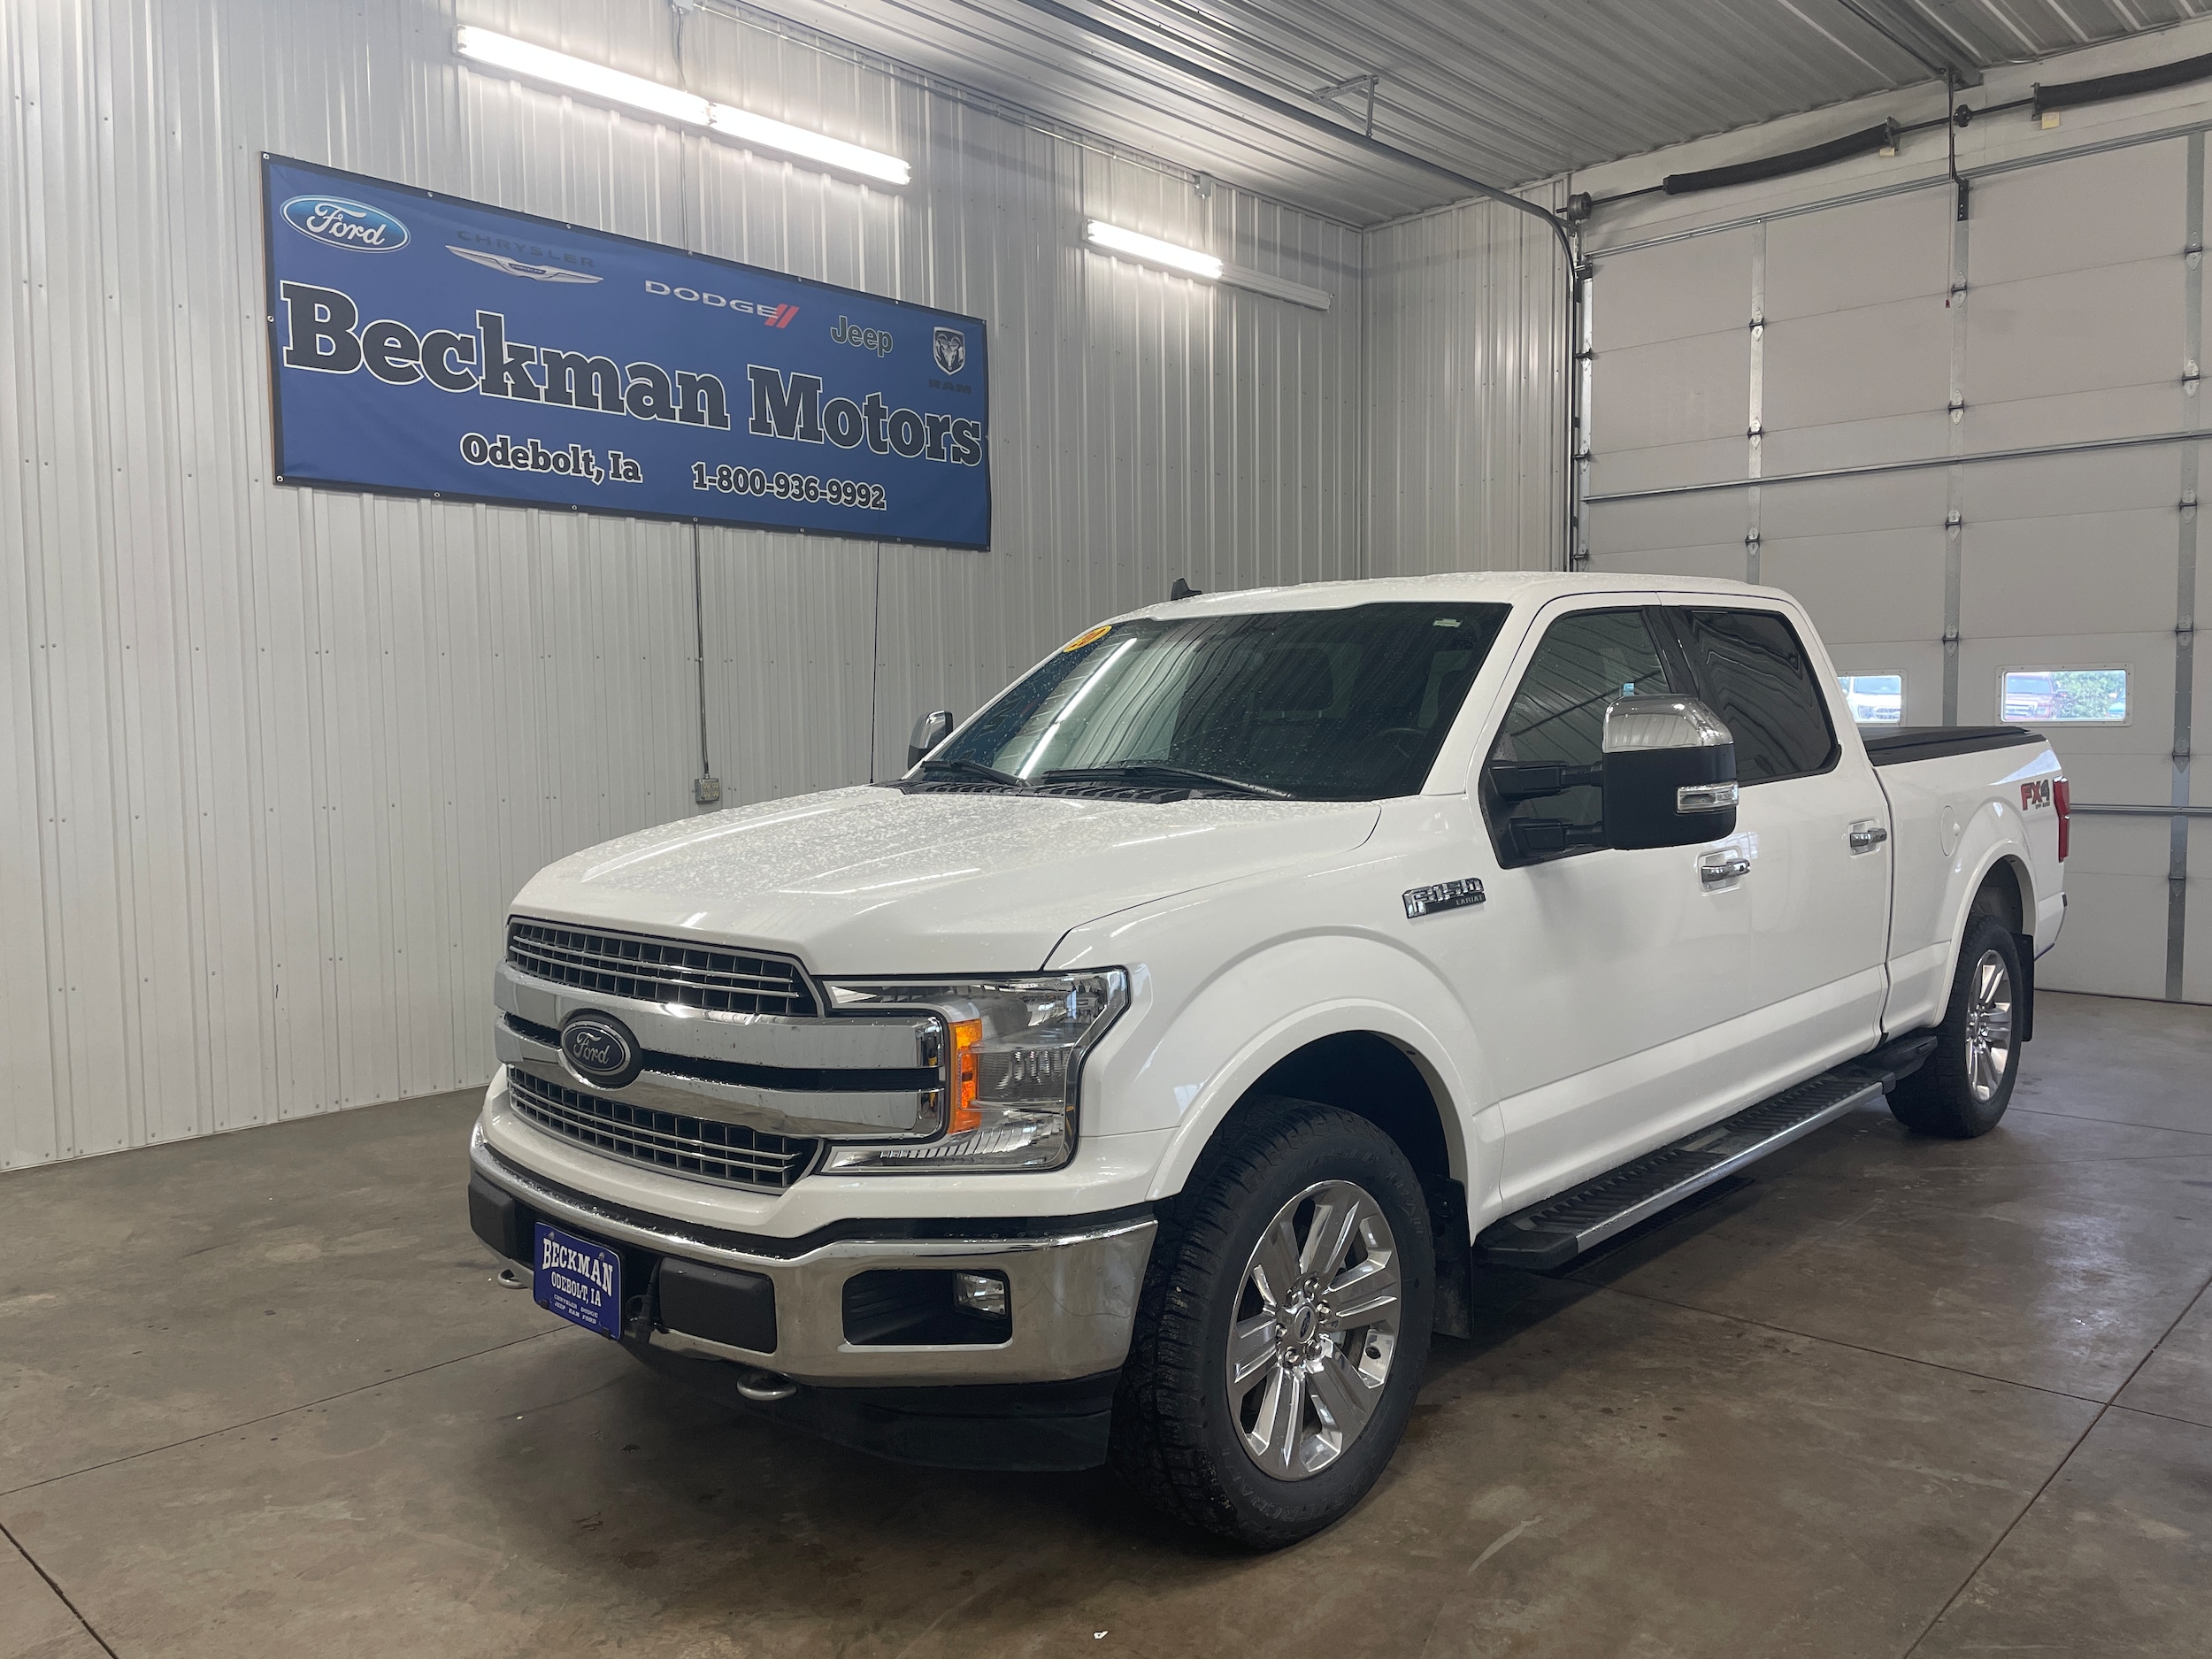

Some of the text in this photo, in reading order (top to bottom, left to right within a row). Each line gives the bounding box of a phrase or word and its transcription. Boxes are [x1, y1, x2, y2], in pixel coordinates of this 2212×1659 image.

[305, 202, 386, 246] Ford
[457, 230, 595, 268] CHRYSLER
[644, 280, 780, 319] DODGE
[830, 315, 893, 357] Jeep
[280, 280, 983, 466] Beckman Motors
[928, 379, 972, 395] RAM
[460, 432, 644, 486] Odebolt, Ia
[691, 461, 887, 511] 1-800-936-9992
[2020, 780, 2050, 811] FX4
[1455, 895, 1484, 906] LARIAT
[573, 1031, 611, 1064] Ford
[542, 1238, 613, 1297] BECKMAN
[551, 1271, 602, 1307] ODEBOLT, IA
[582, 1315, 596, 1324] FORD
